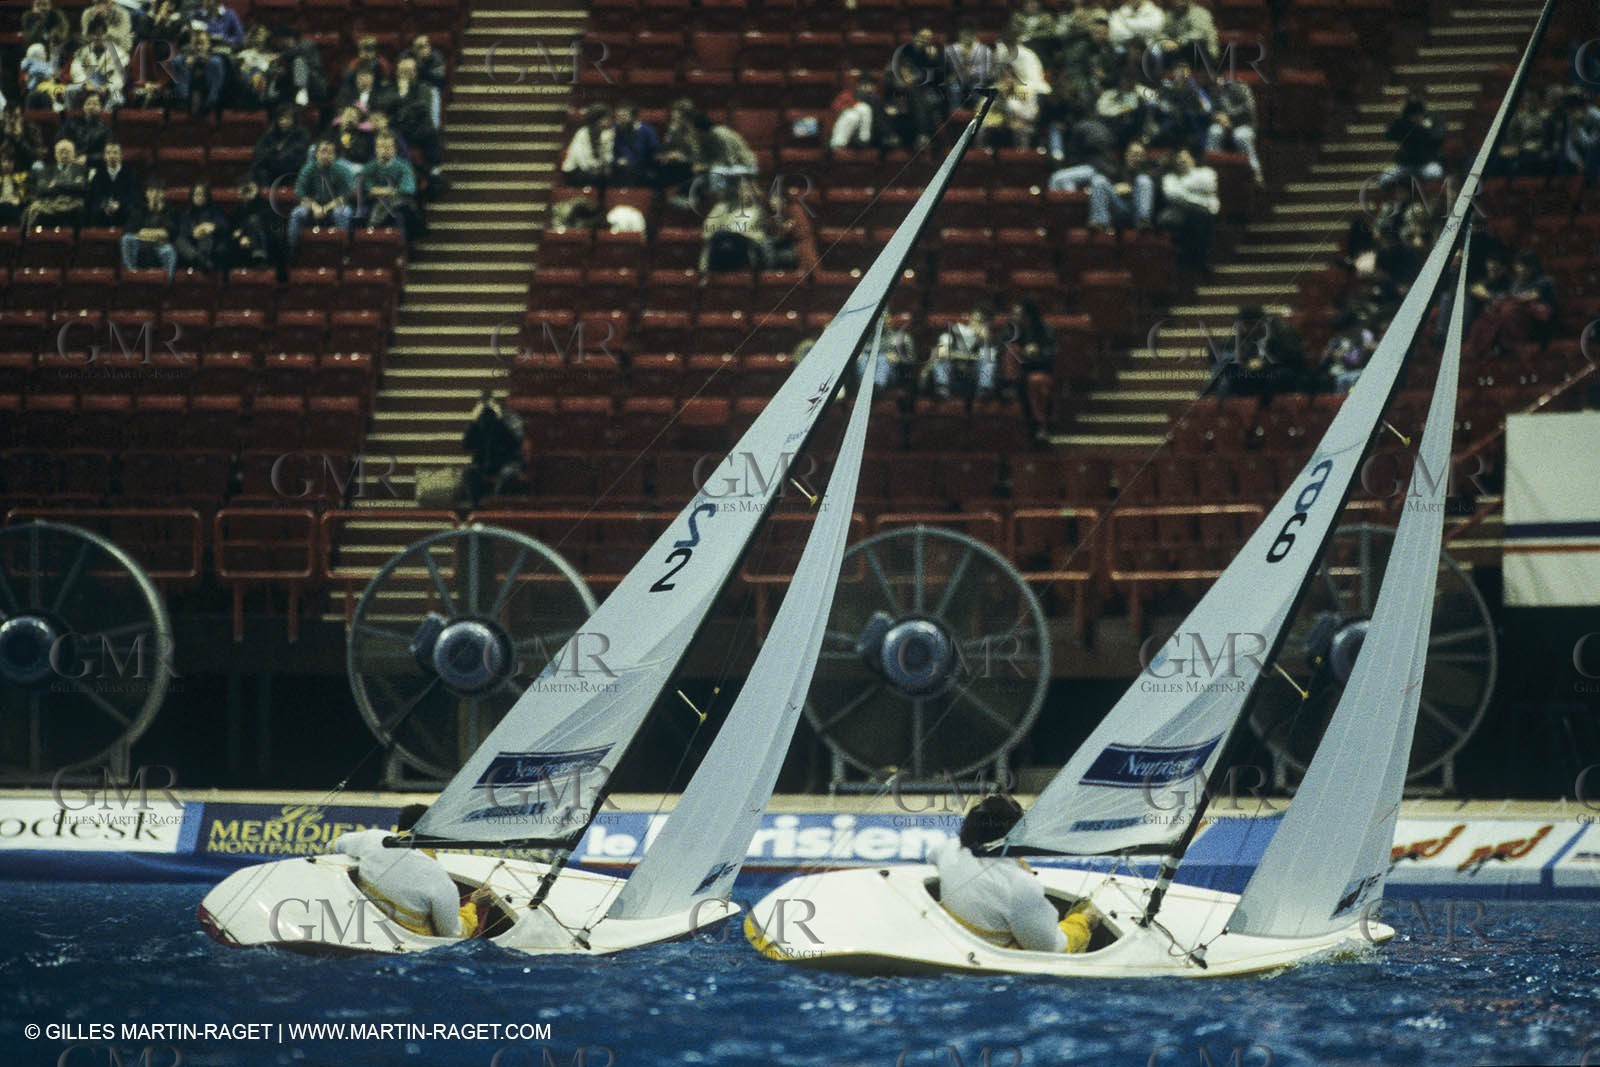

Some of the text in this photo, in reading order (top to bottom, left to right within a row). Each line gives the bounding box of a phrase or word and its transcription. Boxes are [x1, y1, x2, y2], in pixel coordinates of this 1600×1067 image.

[1266, 512, 1308, 564] 6
[650, 548, 693, 592] 2
[586, 825, 638, 857] le
[643, 813, 949, 860] risien
